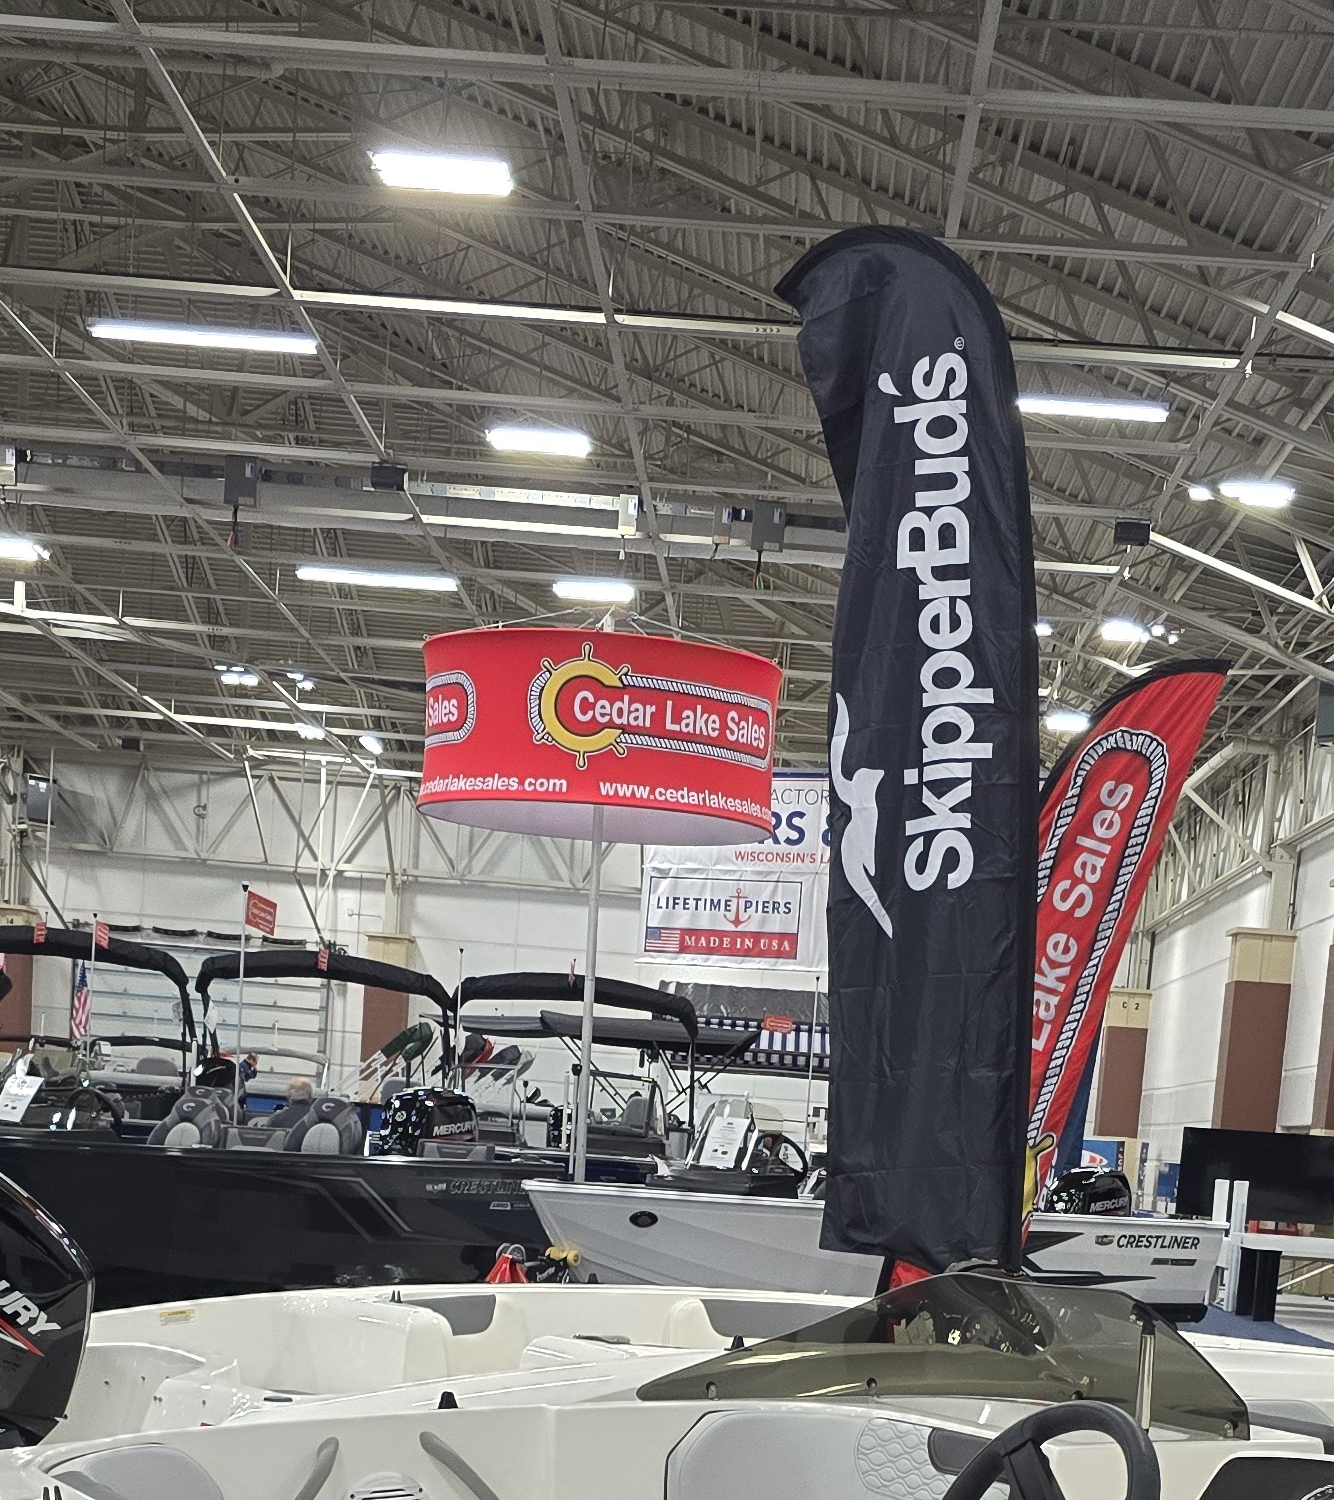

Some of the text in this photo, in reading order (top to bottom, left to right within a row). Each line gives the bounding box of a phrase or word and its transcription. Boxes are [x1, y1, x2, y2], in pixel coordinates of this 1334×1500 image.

[428, 693, 458, 727] Sales
[573, 689, 767, 750] Cedar Lake Sales
[734, 850, 816, 864] WISCONSIN'S
[657, 896, 792, 915] LIFETIME PIERS
[1031, 780, 1134, 1052] Lake Sales
[683, 934, 790, 951] MADE IN USA
[1117, 1234, 1200, 1250] CRESTLINER
